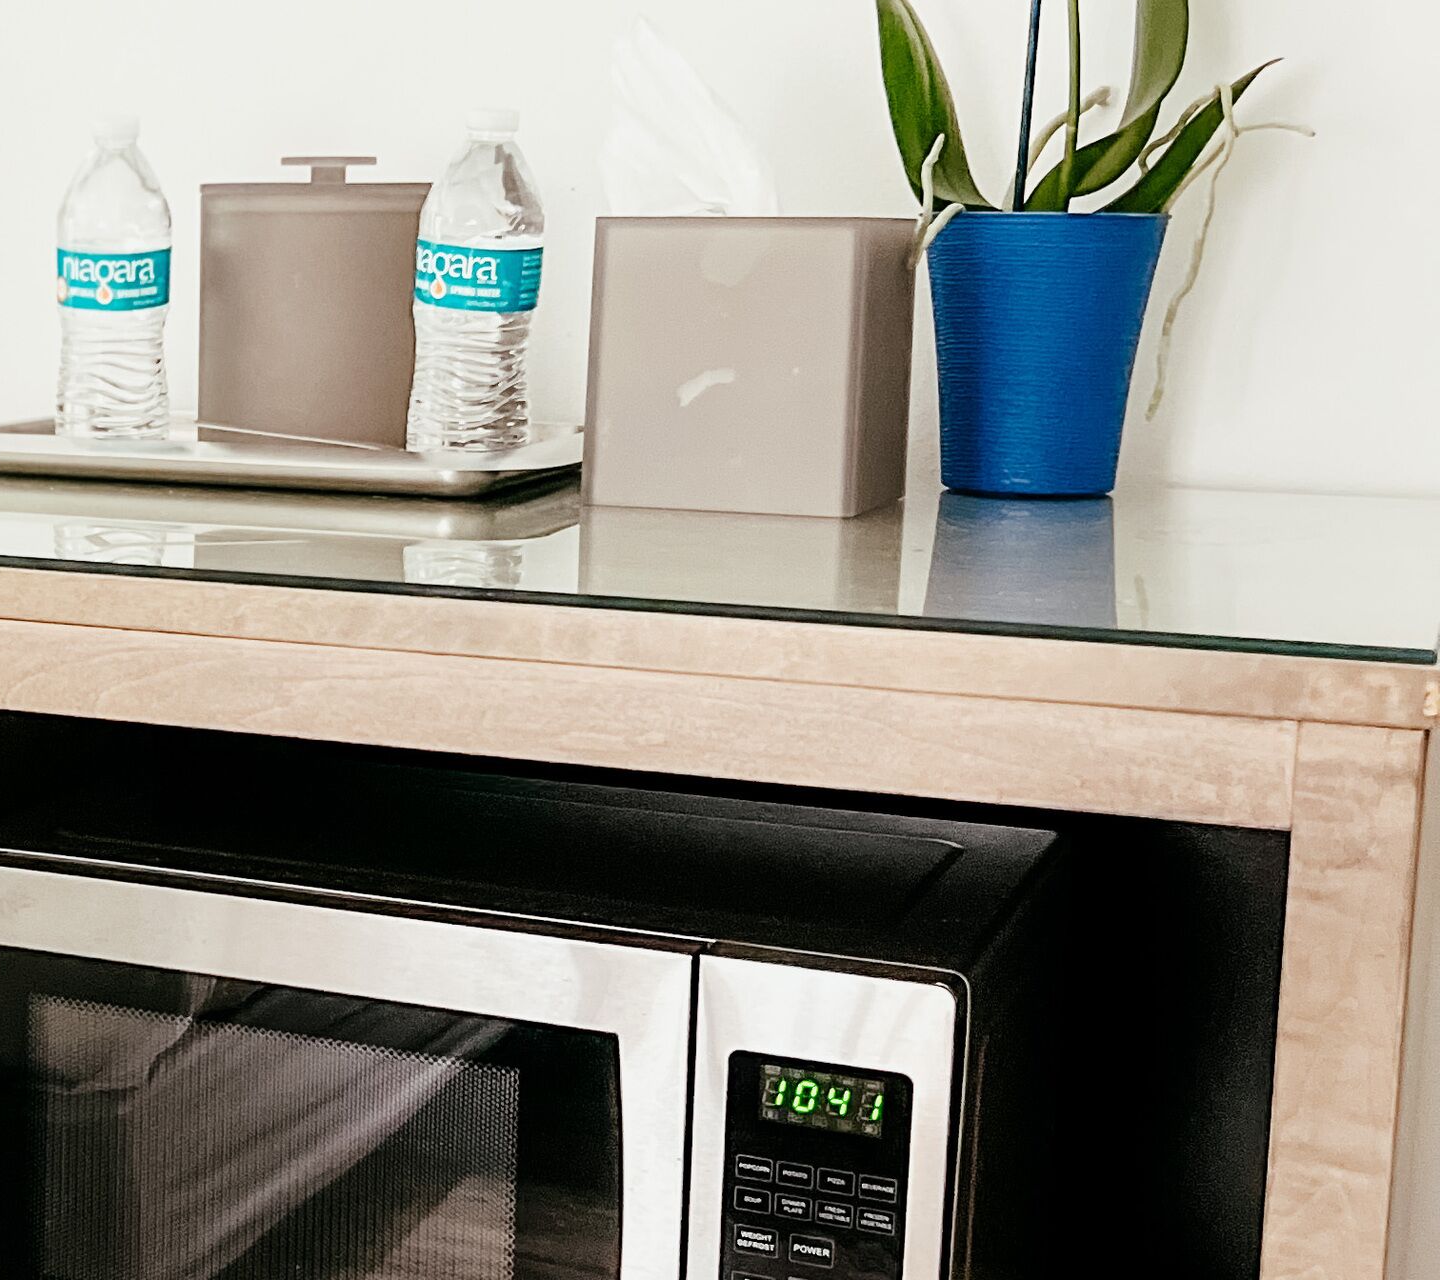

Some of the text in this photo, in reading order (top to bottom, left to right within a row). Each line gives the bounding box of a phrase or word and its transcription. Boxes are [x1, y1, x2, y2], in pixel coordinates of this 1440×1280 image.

[63, 256, 155, 284] niagara
[740, 1230, 772, 1242] WEIGHT
[793, 1243, 831, 1258] POWER
